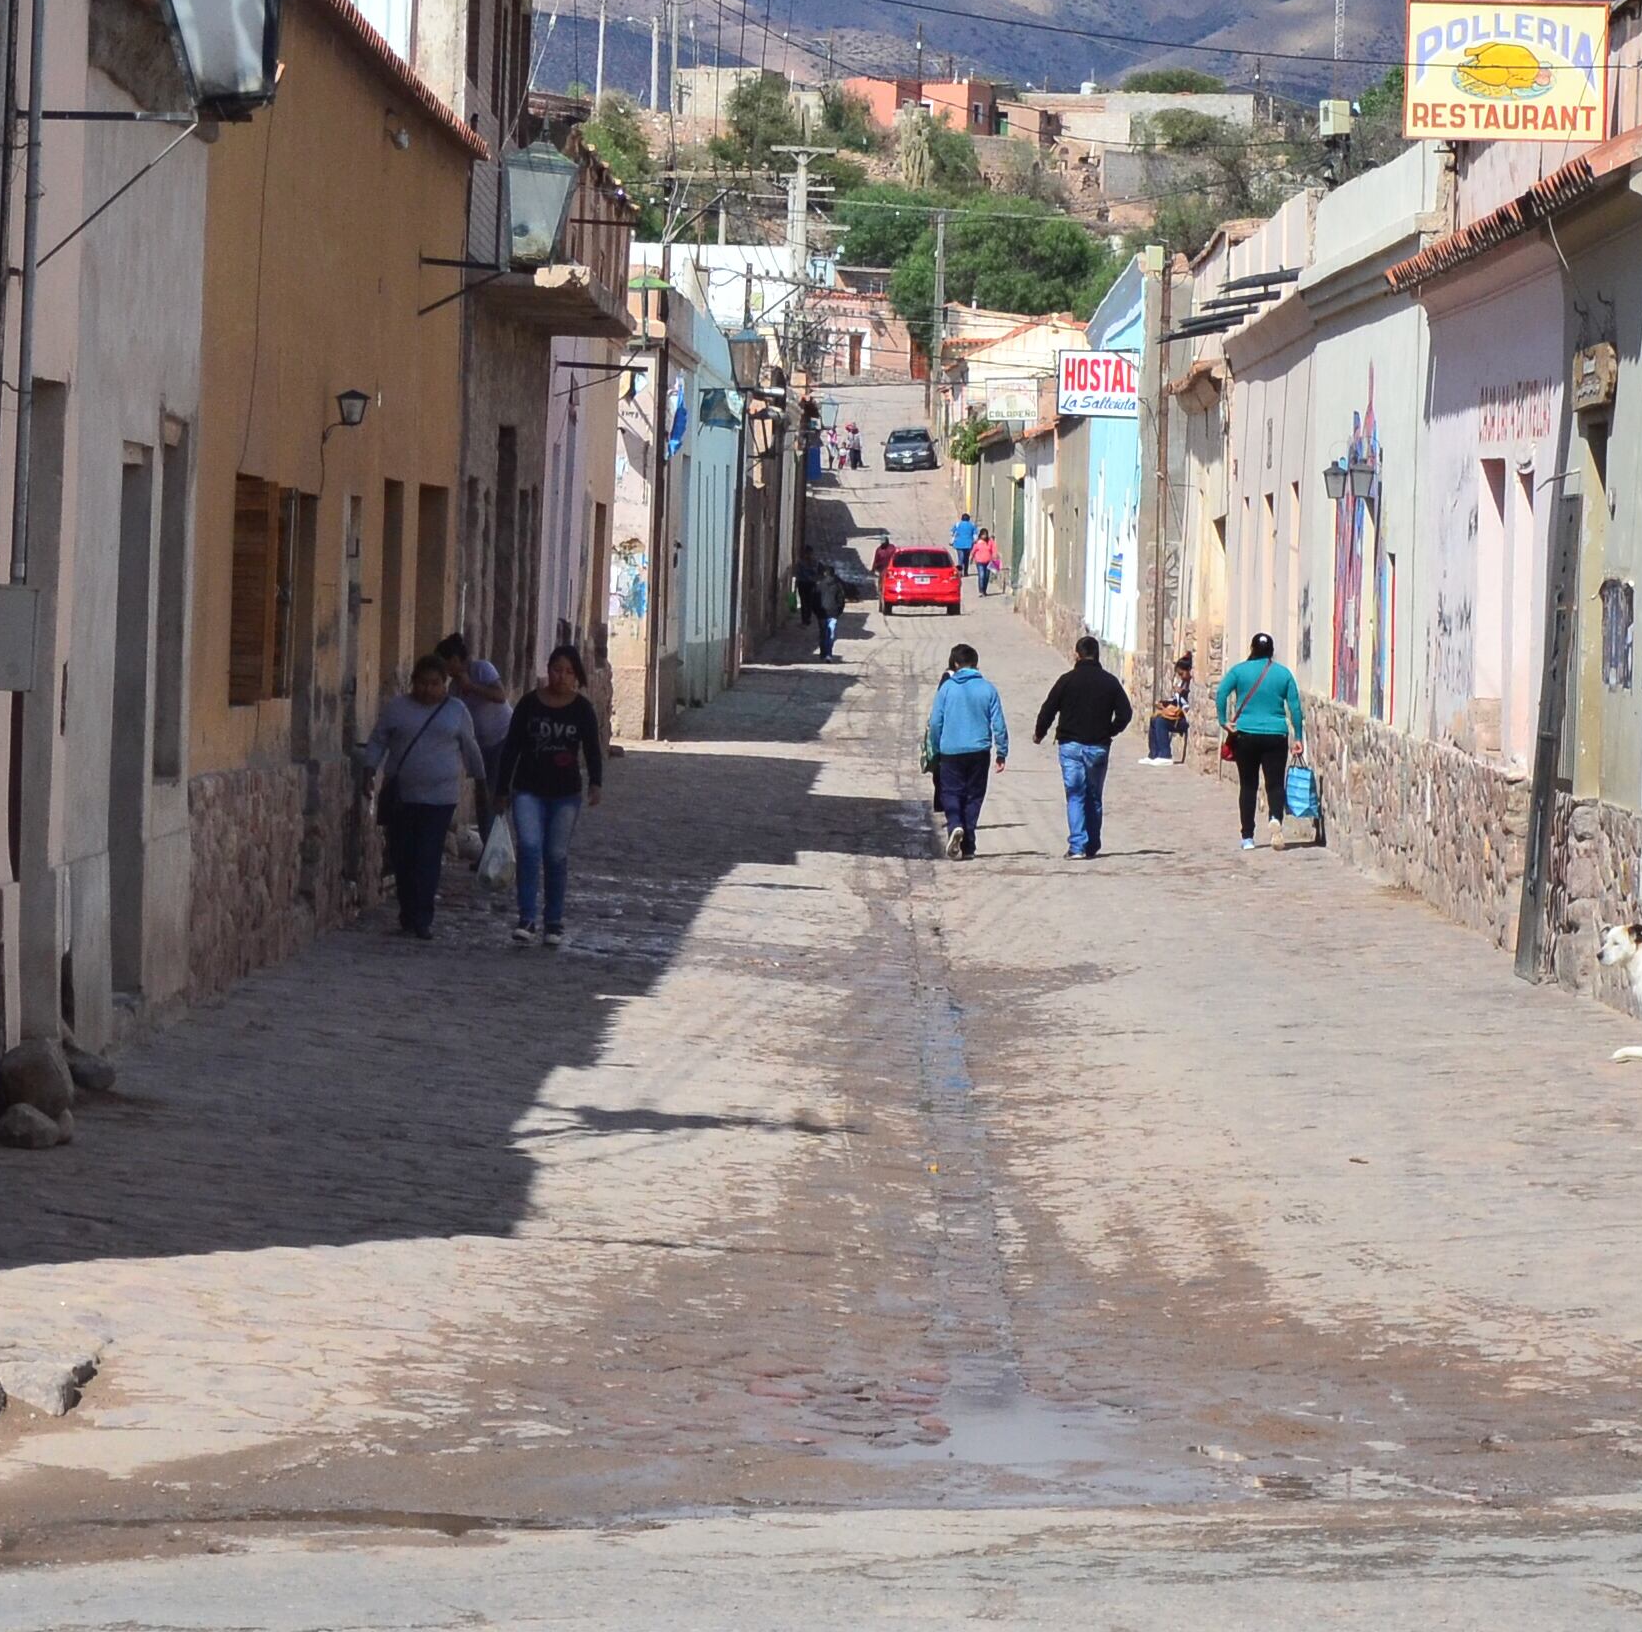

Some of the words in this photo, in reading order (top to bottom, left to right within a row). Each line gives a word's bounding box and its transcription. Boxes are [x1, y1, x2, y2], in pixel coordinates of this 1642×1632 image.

[1415, 13, 1596, 91] POLLERIA
[1412, 103, 1596, 131] RESTAURANT
[1064, 358, 1136, 393] HOSTAL
[1061, 394, 1077, 412] La
